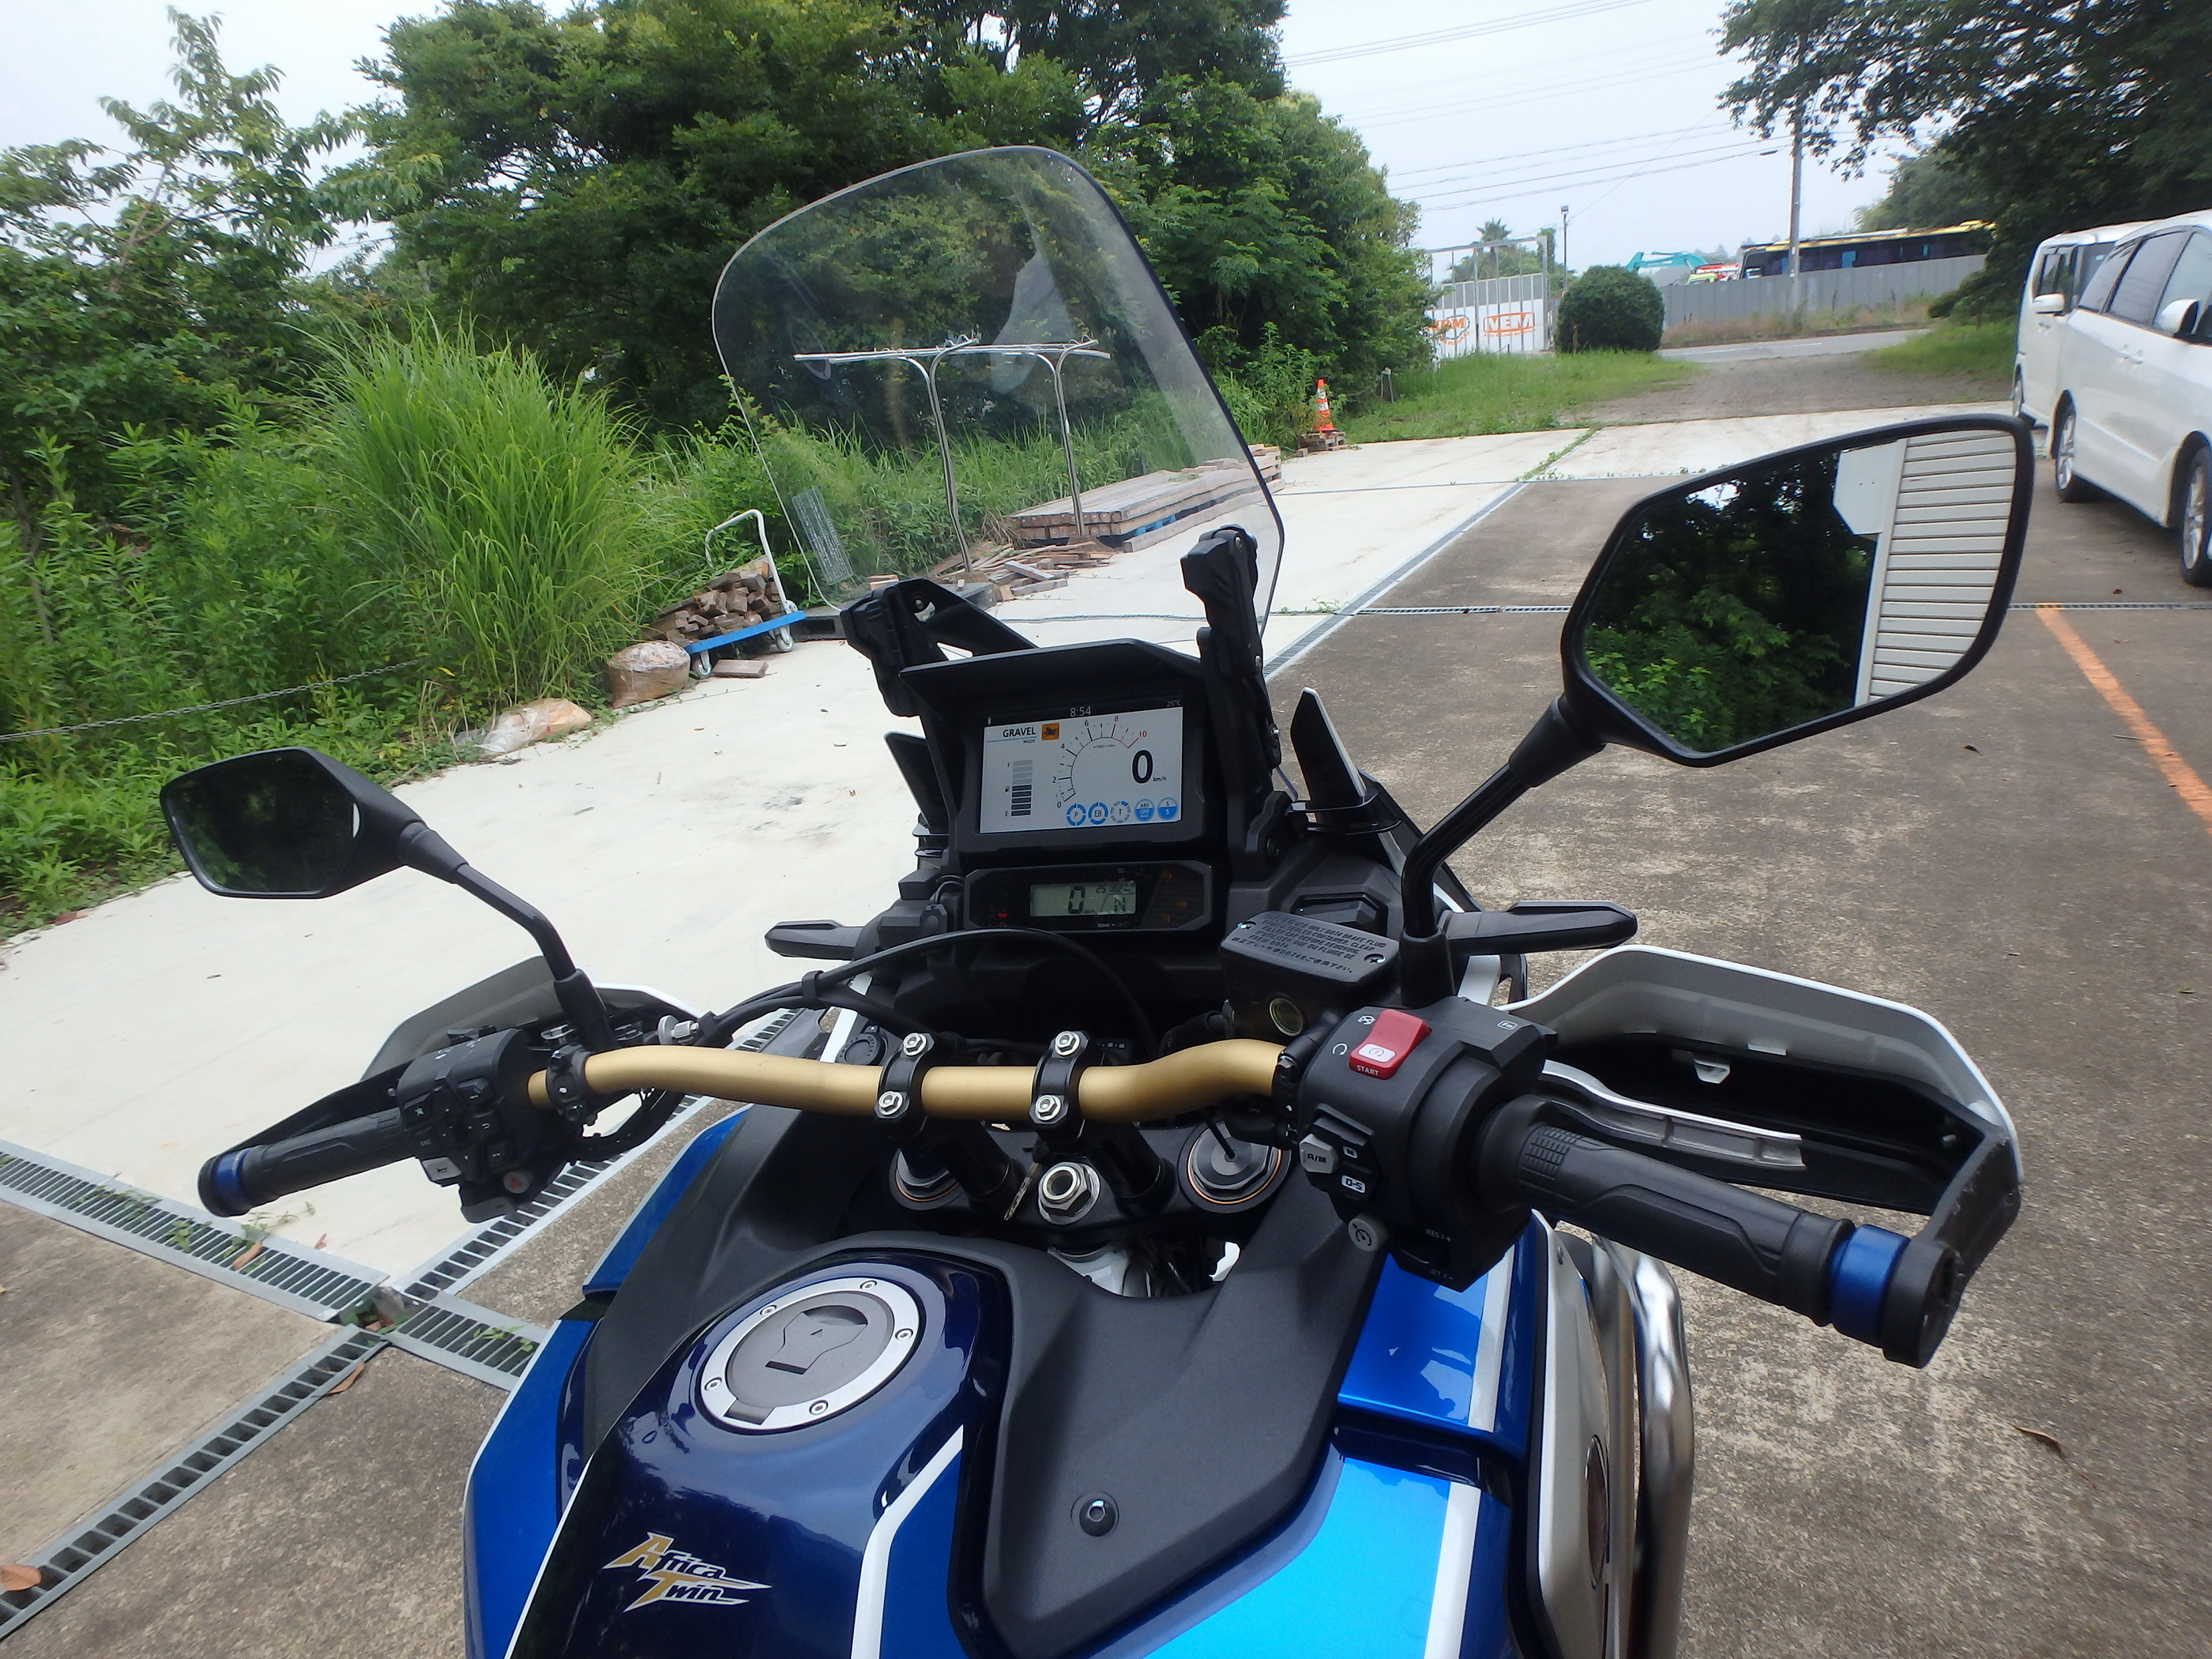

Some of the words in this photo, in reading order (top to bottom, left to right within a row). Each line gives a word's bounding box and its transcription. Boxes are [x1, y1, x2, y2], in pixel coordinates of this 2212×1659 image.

[1070, 705, 1092, 717] 8:54
[1003, 727, 1036, 738] GRAVEL
[1132, 750, 1153, 784] 0
[1068, 886, 1085, 914] 0
[1114, 897, 1126, 912] N
[1248, 935, 1269, 944] FREIN
[1261, 926, 1285, 935] FILLER
[1298, 935, 1325, 946] BEFORE
[1286, 926, 1311, 937] SEALED
[1350, 942, 1375, 951] CLEAN
[1295, 920, 1308, 929] USE
[1342, 934, 1366, 942] BRAKE
[1366, 939, 1386, 948] FLUID
[1292, 939, 1307, 948] QUE
[1318, 946, 1344, 957] FLUIDE
[1344, 952, 1356, 961] DE
[1500, 1021, 1515, 1030] Fn
[1356, 1064, 1379, 1076] START
[1307, 1153, 1327, 1164] A/M
[1346, 1147, 1356, 1157] N
[1345, 1179, 1364, 1191] D-S
[1426, 1228, 1440, 1239] RES
[602, 1531, 728, 1582] Africa
[623, 1571, 754, 1612] Twin
